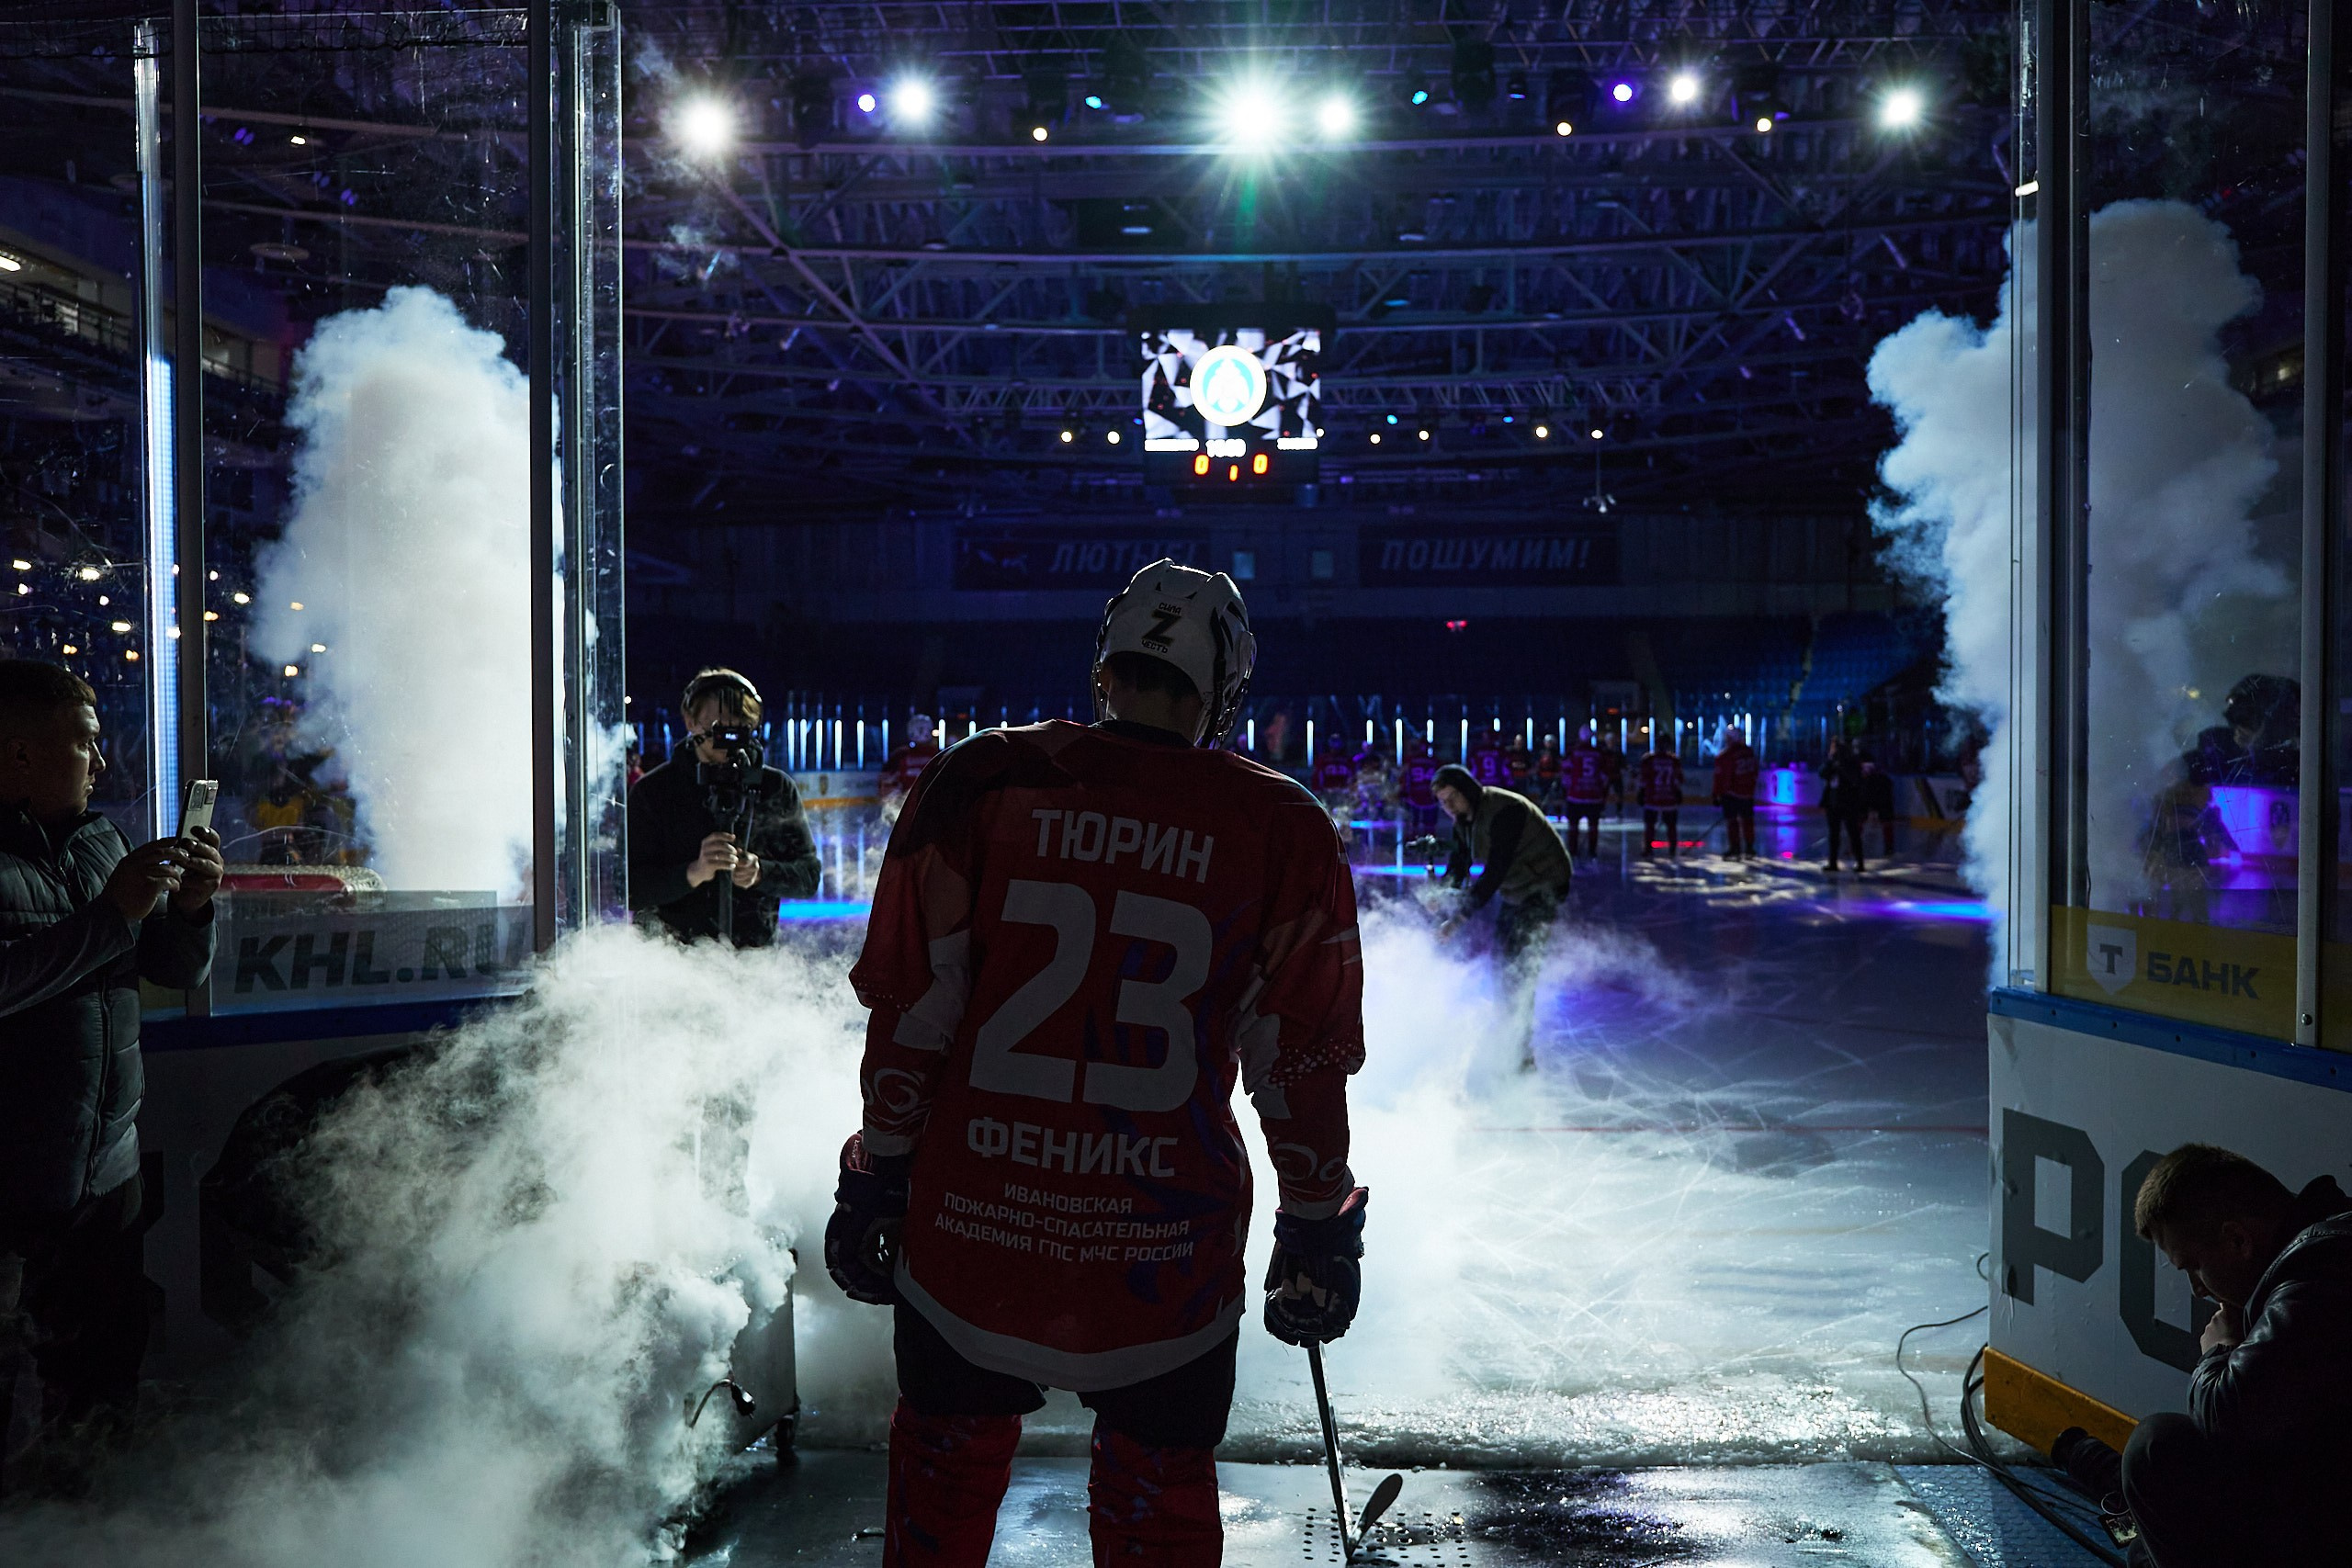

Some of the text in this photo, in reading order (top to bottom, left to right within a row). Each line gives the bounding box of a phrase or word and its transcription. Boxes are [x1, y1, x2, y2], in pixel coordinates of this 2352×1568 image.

[1381, 537, 1591, 570] ПОШУМИМ!
[1141, 639, 1169, 655] ЧЕСТЬ
[1142, 609, 1182, 647] Z
[1032, 807, 1215, 884] ТЮРИН
[968, 878, 1214, 1113] 23
[2147, 951, 2261, 999] БАНК
[967, 1116, 1179, 1178] ФЕНИКС
[944, 1191, 1190, 1239] ПОЖАРНО-СПАСАТЕЛЬНАЯ
[1004, 1182, 1133, 1214] ИВАНОВСКАЯ
[934, 1212, 1193, 1263] АКАДЕМИЯ ГПС МЧС РОССИИ
